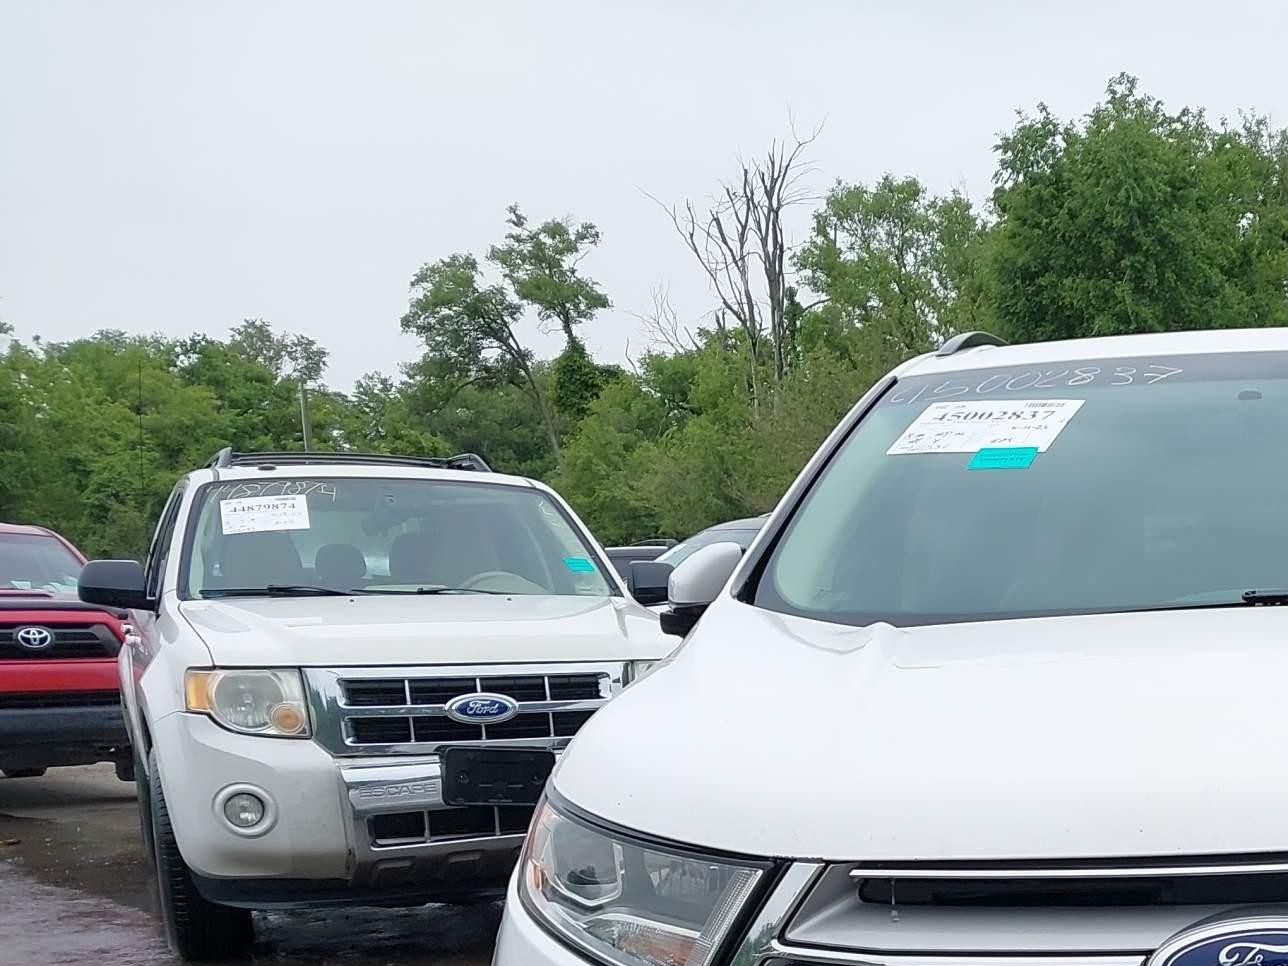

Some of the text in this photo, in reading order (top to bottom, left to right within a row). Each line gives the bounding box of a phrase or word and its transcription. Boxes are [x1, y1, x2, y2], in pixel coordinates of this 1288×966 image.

[932, 410, 1057, 422] 45002837
[229, 503, 296, 513] 44879874
[467, 700, 499, 715] Ford
[360, 783, 437, 798] ESCAPE
